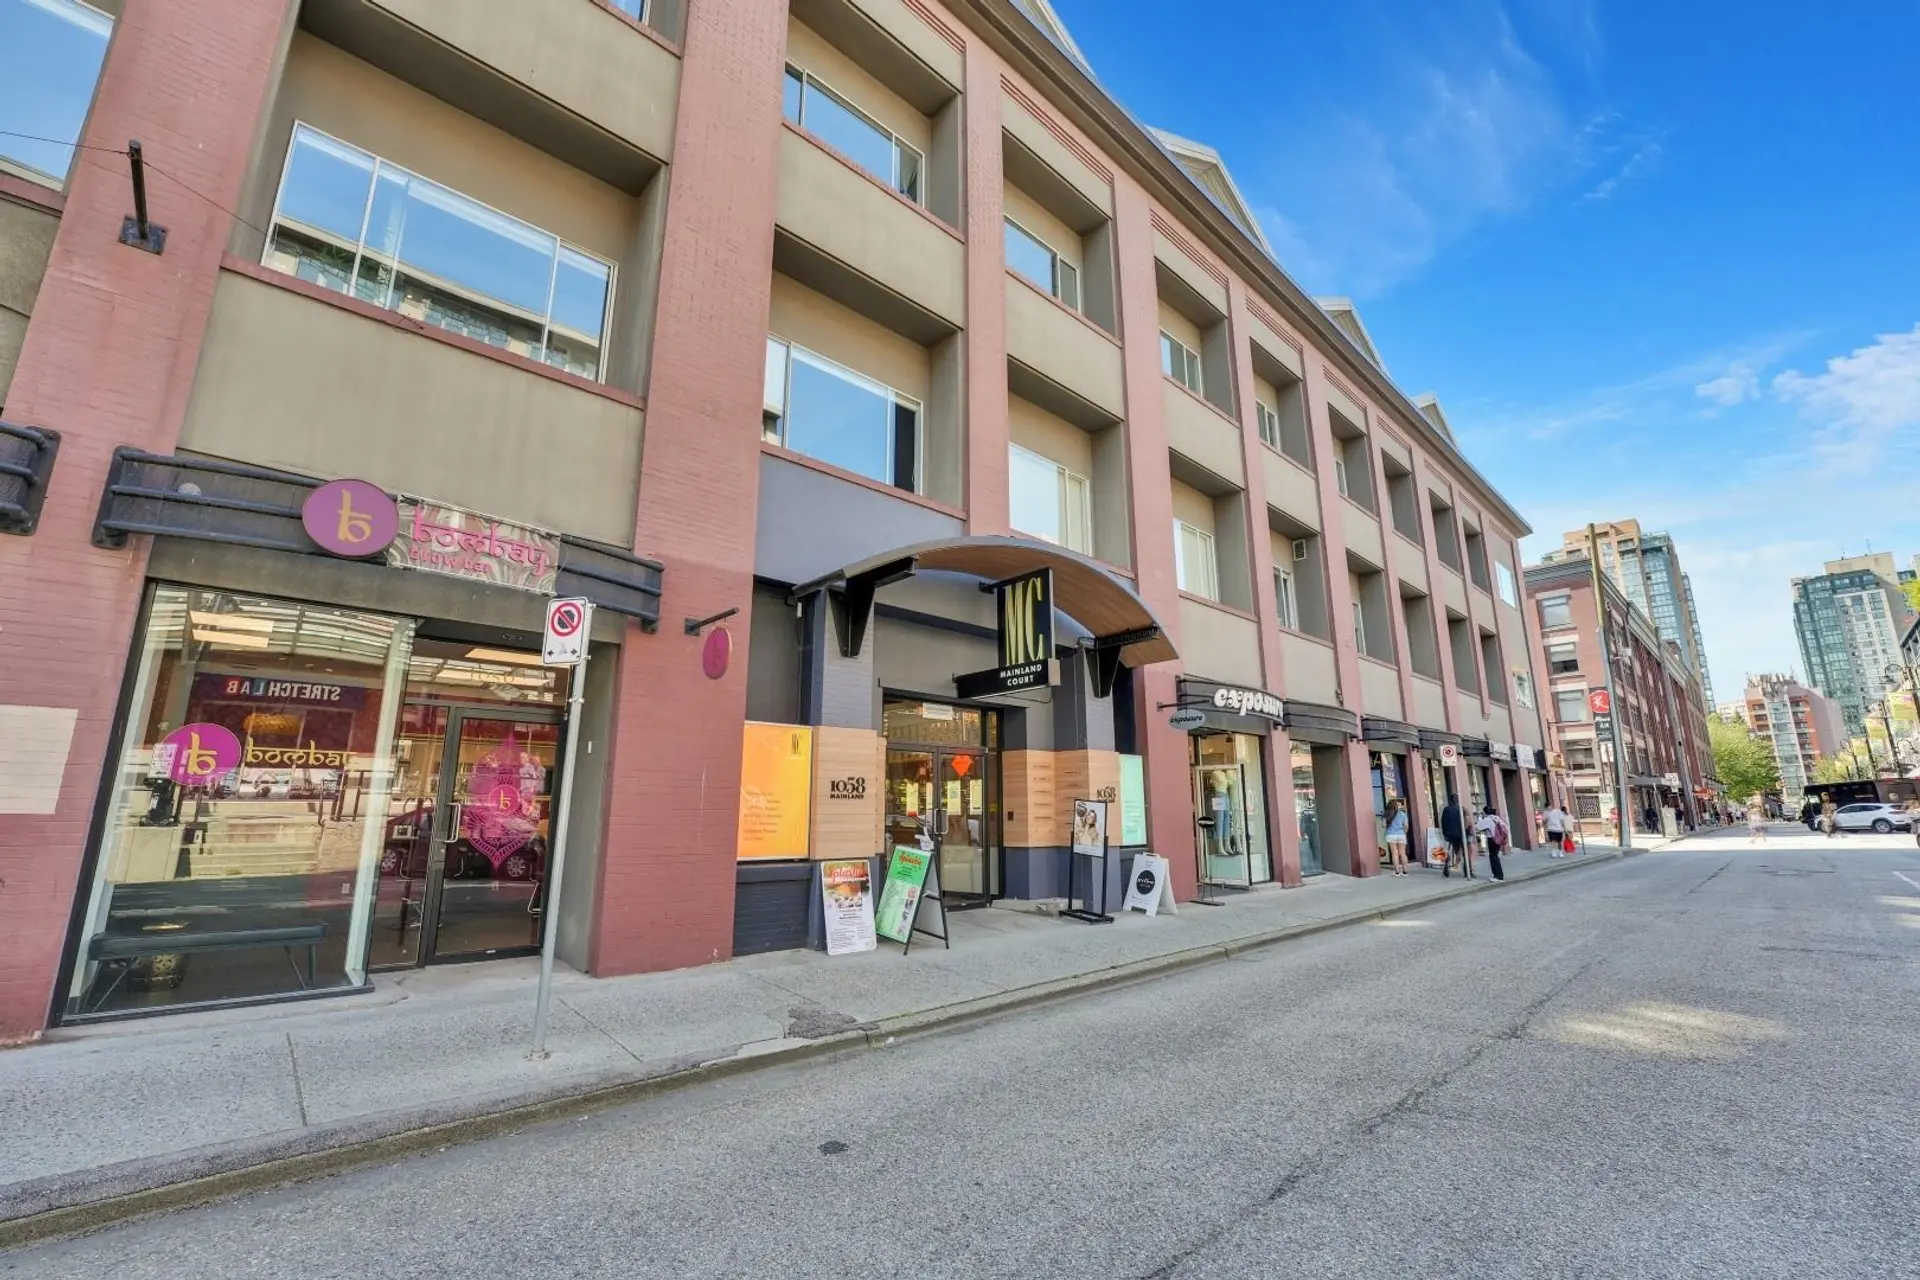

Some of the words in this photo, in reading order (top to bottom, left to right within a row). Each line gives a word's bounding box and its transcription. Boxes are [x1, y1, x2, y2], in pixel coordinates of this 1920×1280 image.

[412, 504, 551, 577] bombay
[1002, 577, 1044, 667] MC
[1000, 664, 1042, 678] MAINLAND
[1007, 675, 1034, 686] COURT
[1213, 688, 1284, 718] exposur
[1170, 715, 1203, 725] exposure
[829, 777, 866, 794] 1058
